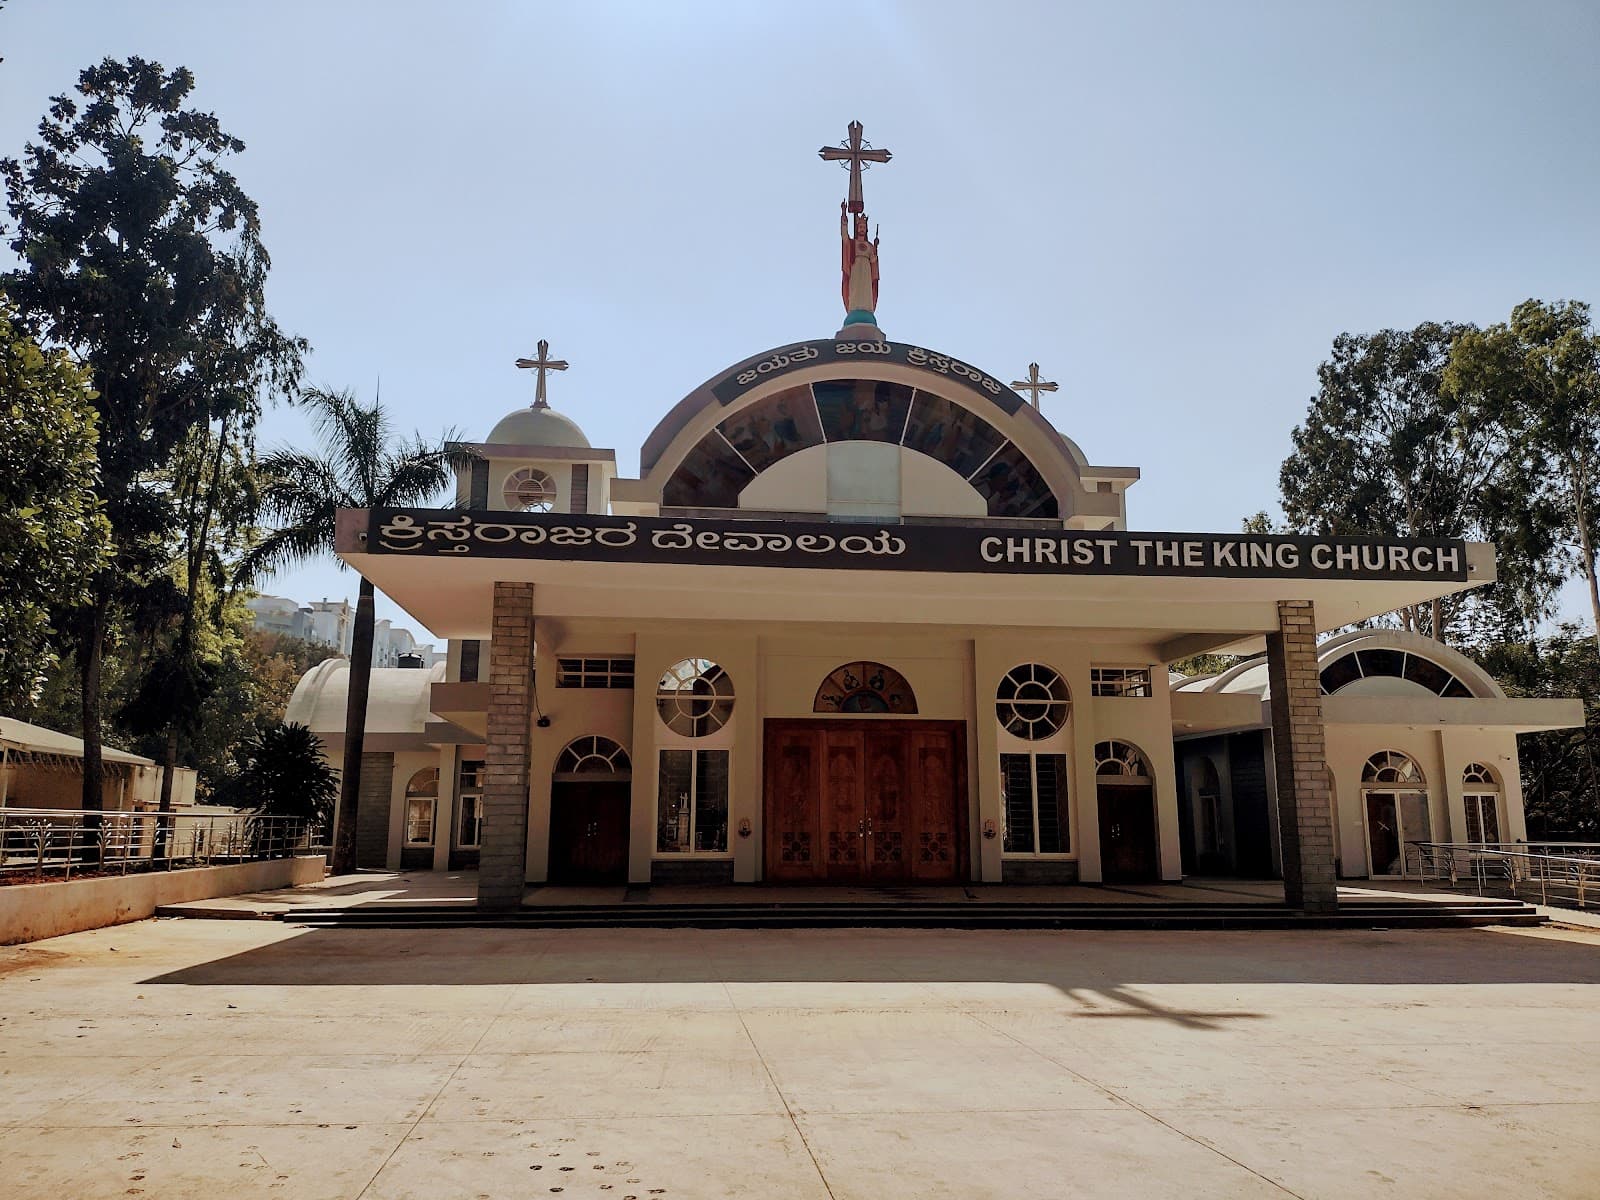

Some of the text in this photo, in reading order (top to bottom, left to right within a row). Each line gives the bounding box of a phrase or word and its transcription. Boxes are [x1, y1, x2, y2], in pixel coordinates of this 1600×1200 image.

[835, 340, 892, 355] ಜಯ
[379, 515, 906, 555] ಕ್ರಿಸ್ತರಾಜರ ದೇವಾಲಯ
[980, 536, 1459, 572] CHRIST THE KING CHURCH
